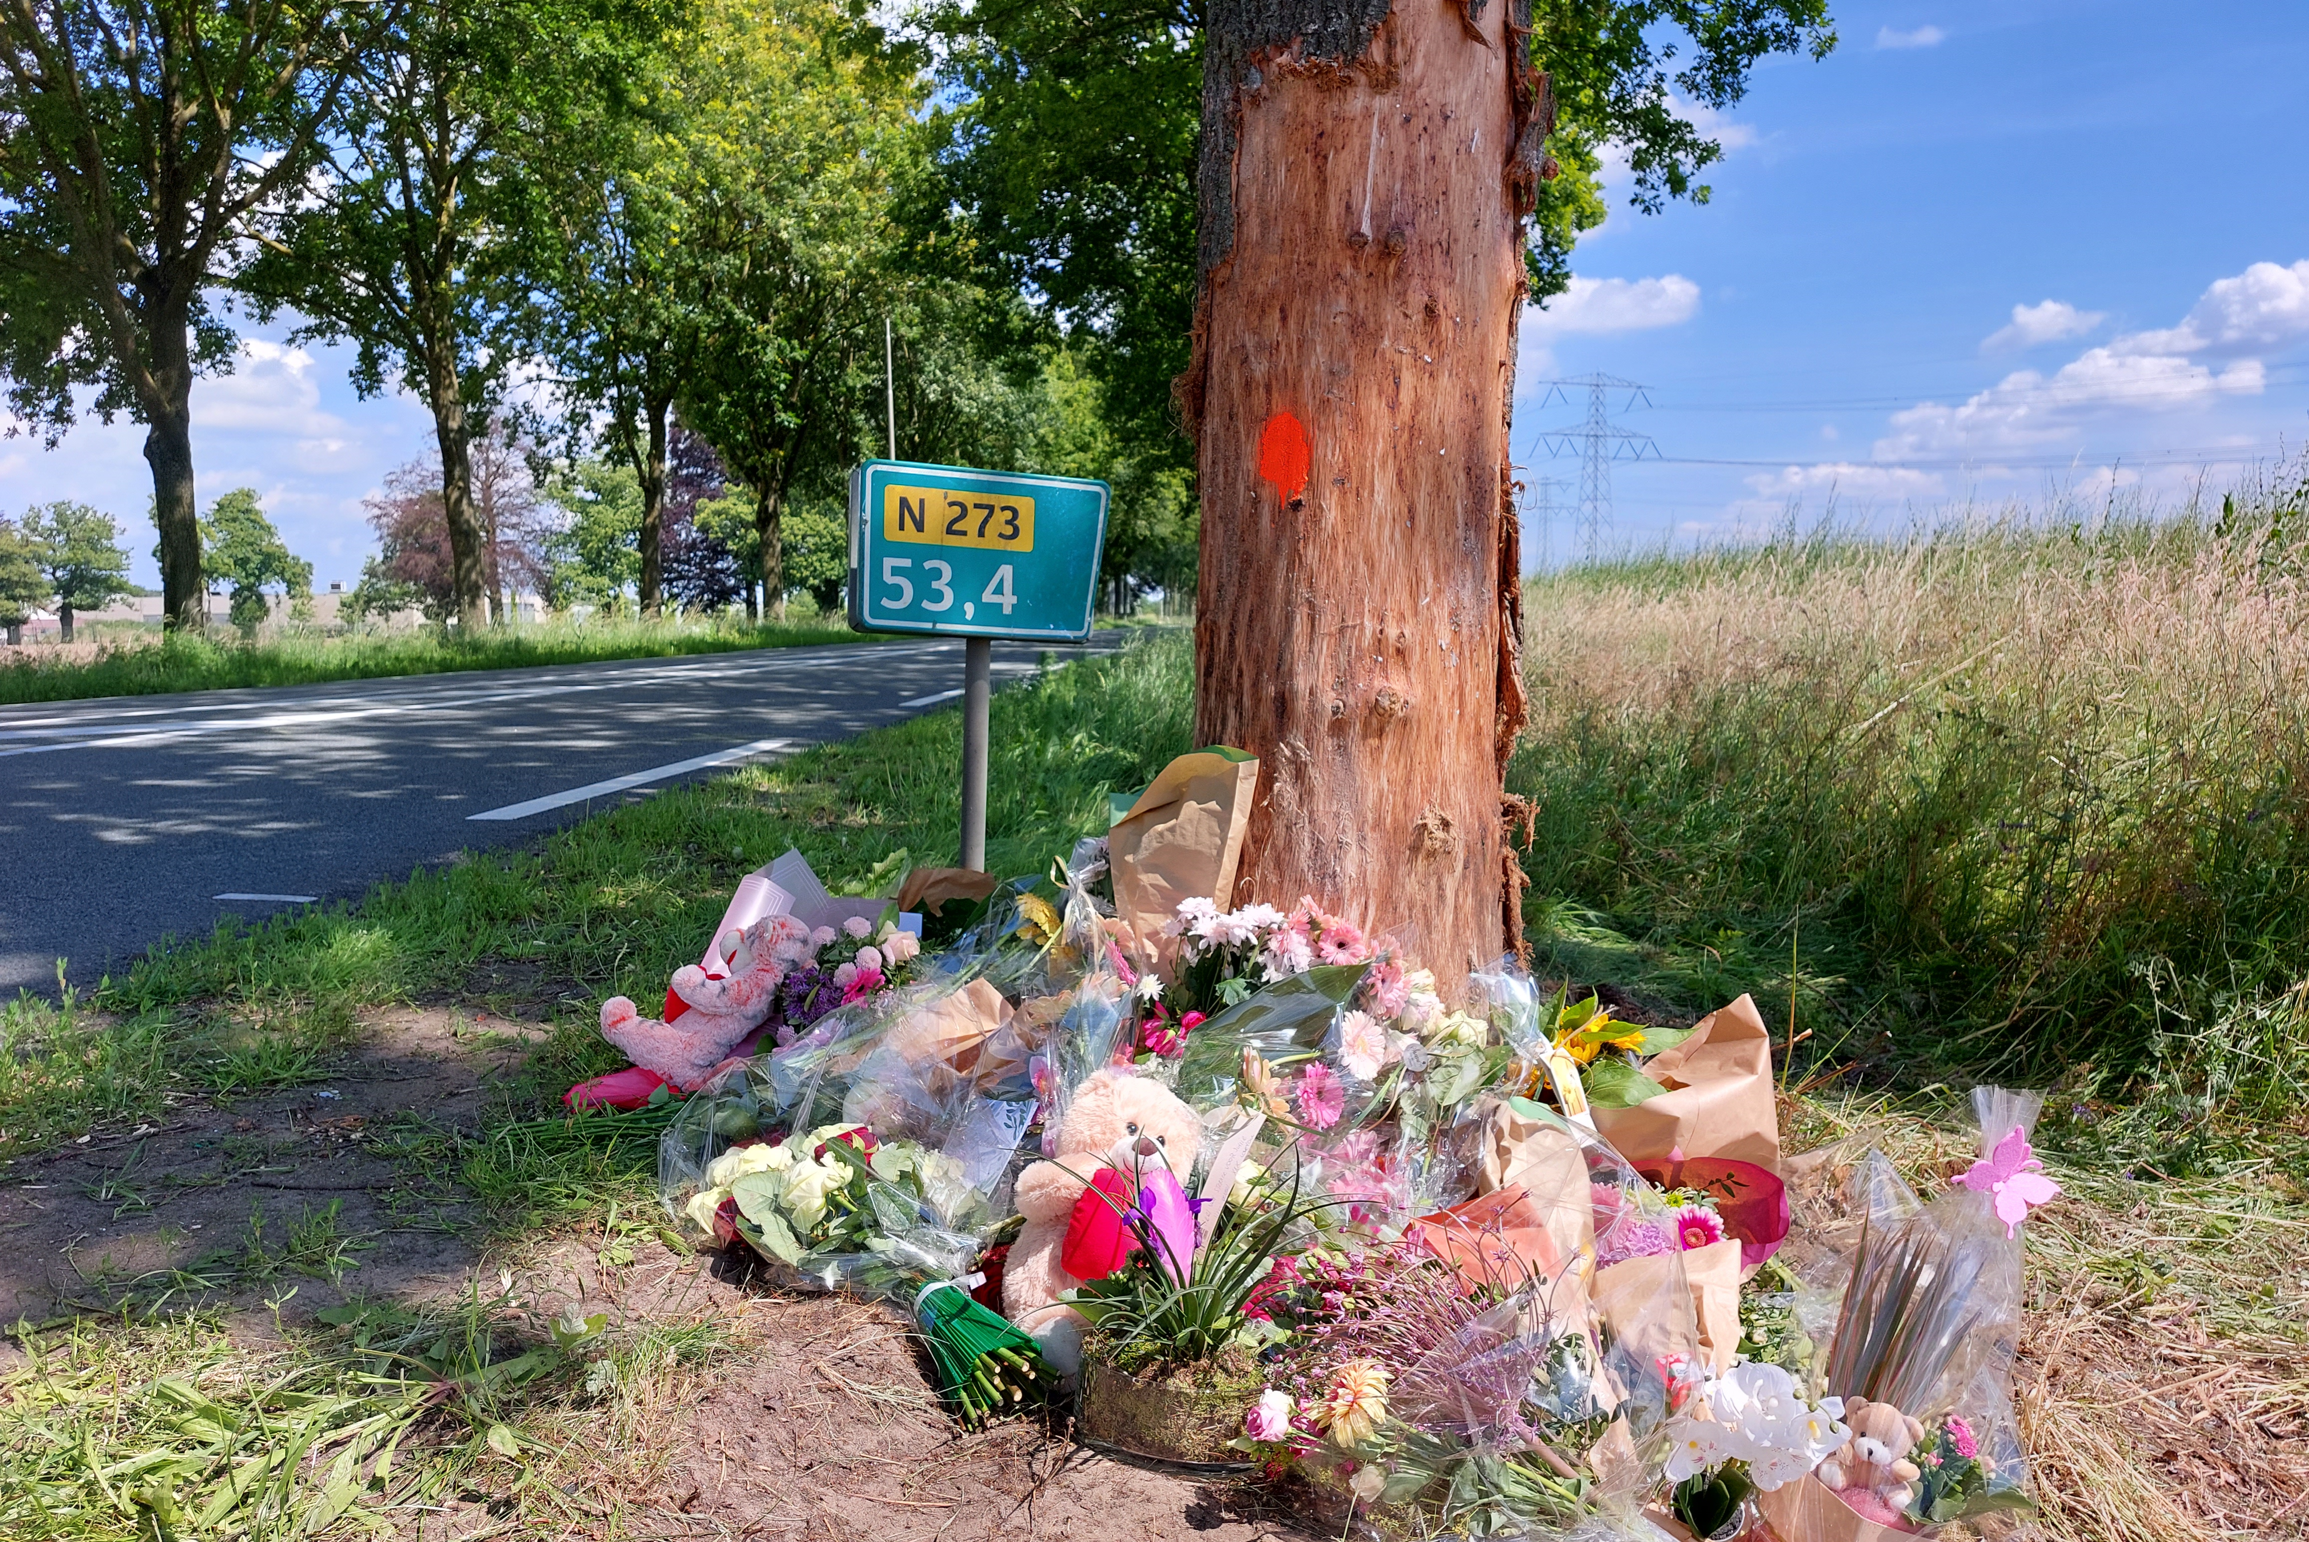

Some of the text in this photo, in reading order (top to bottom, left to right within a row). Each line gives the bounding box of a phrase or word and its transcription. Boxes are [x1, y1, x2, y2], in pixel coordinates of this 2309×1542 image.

[898, 496, 1021, 541] N 273
[880, 556, 1018, 621] 53,4
